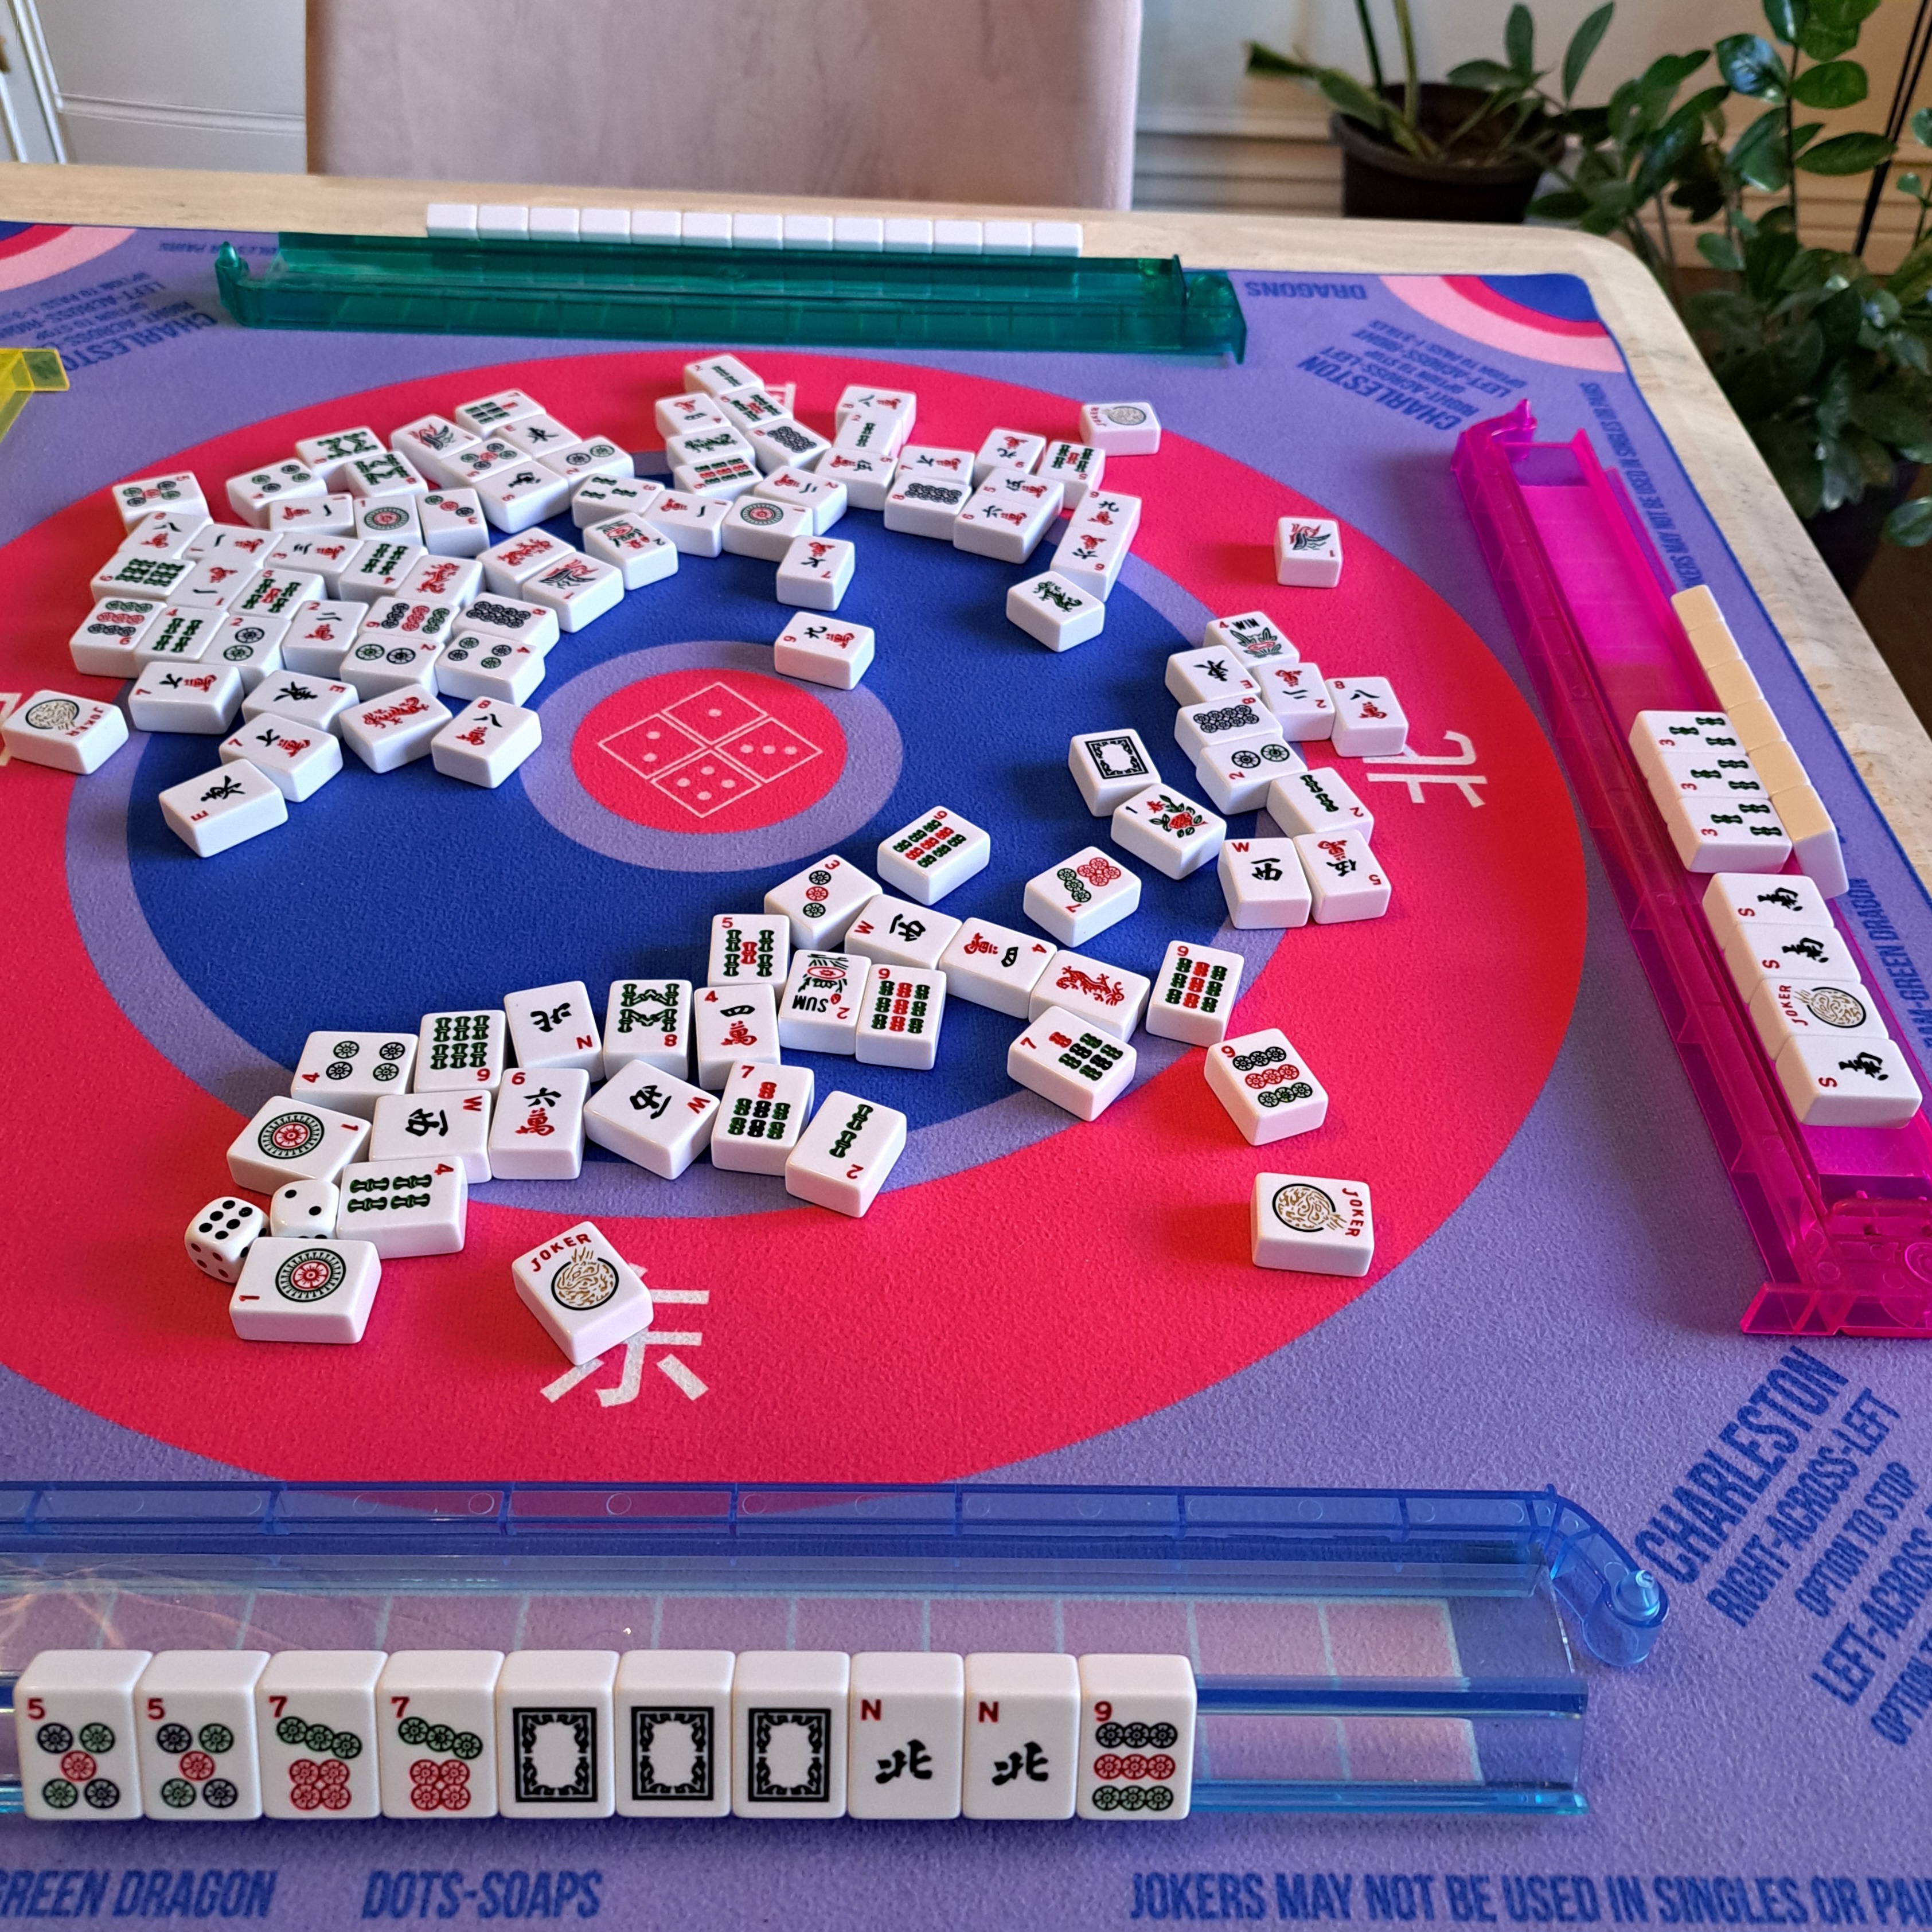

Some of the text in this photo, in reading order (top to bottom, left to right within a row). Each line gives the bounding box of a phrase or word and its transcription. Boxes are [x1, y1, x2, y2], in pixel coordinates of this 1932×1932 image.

[1244, 282, 1367, 299] DRAGONS
[60, 313, 218, 371] CHARLESTO
[1297, 356, 1461, 430] CHARLESTON
[1232, 619, 1259, 630] WIN
[65, 707, 103, 737] JOKER
[853, 919, 874, 934] W
[792, 995, 850, 1019] 2 SUM
[1778, 985, 1809, 1026] JOKER
[576, 1035, 592, 1049] N
[665, 1034, 677, 1047] 8
[1020, 1037, 1036, 1049] 7
[1221, 1046, 1235, 1057] 9
[477, 1068, 490, 1081] 6
[512, 1072, 525, 1084] 6
[741, 1065, 755, 1078] 7
[463, 1096, 482, 1111] W
[687, 1097, 711, 1114] W
[435, 1164, 454, 1175] 4
[846, 1164, 864, 1179] 2
[1342, 1187, 1365, 1236] JOKER
[530, 1232, 592, 1273] JOKER
[1634, 1345, 1849, 1584] CHARLESTON
[1706, 1387, 1900, 1627] RIGHT-ACROSS-LEFT
[1794, 1461, 1919, 1618] OPTION TO STOP
[28, 1698, 45, 1720] 5
[148, 1698, 165, 1720] 5
[269, 1696, 287, 1718] 7
[391, 1696, 409, 1718] 7
[861, 1699, 881, 1720] N
[978, 1701, 998, 1722] N
[1094, 1701, 1112, 1722] 9
[0, 1869, 278, 1918] REEN DRAGON
[362, 1869, 602, 1919] DOTS-SOAPS
[1130, 1872, 1266, 1920] JOKERS
[1274, 1873, 1352, 1920] MAY
[1364, 1874, 1434, 1921] NOT
[1445, 1874, 1497, 1923] BE
[1501, 1874, 1601, 1923] USED
[1606, 1875, 1649, 1923] IN
[1652, 1875, 1808, 1924] SINGLES
[1810, 1875, 1868, 1925] OR
